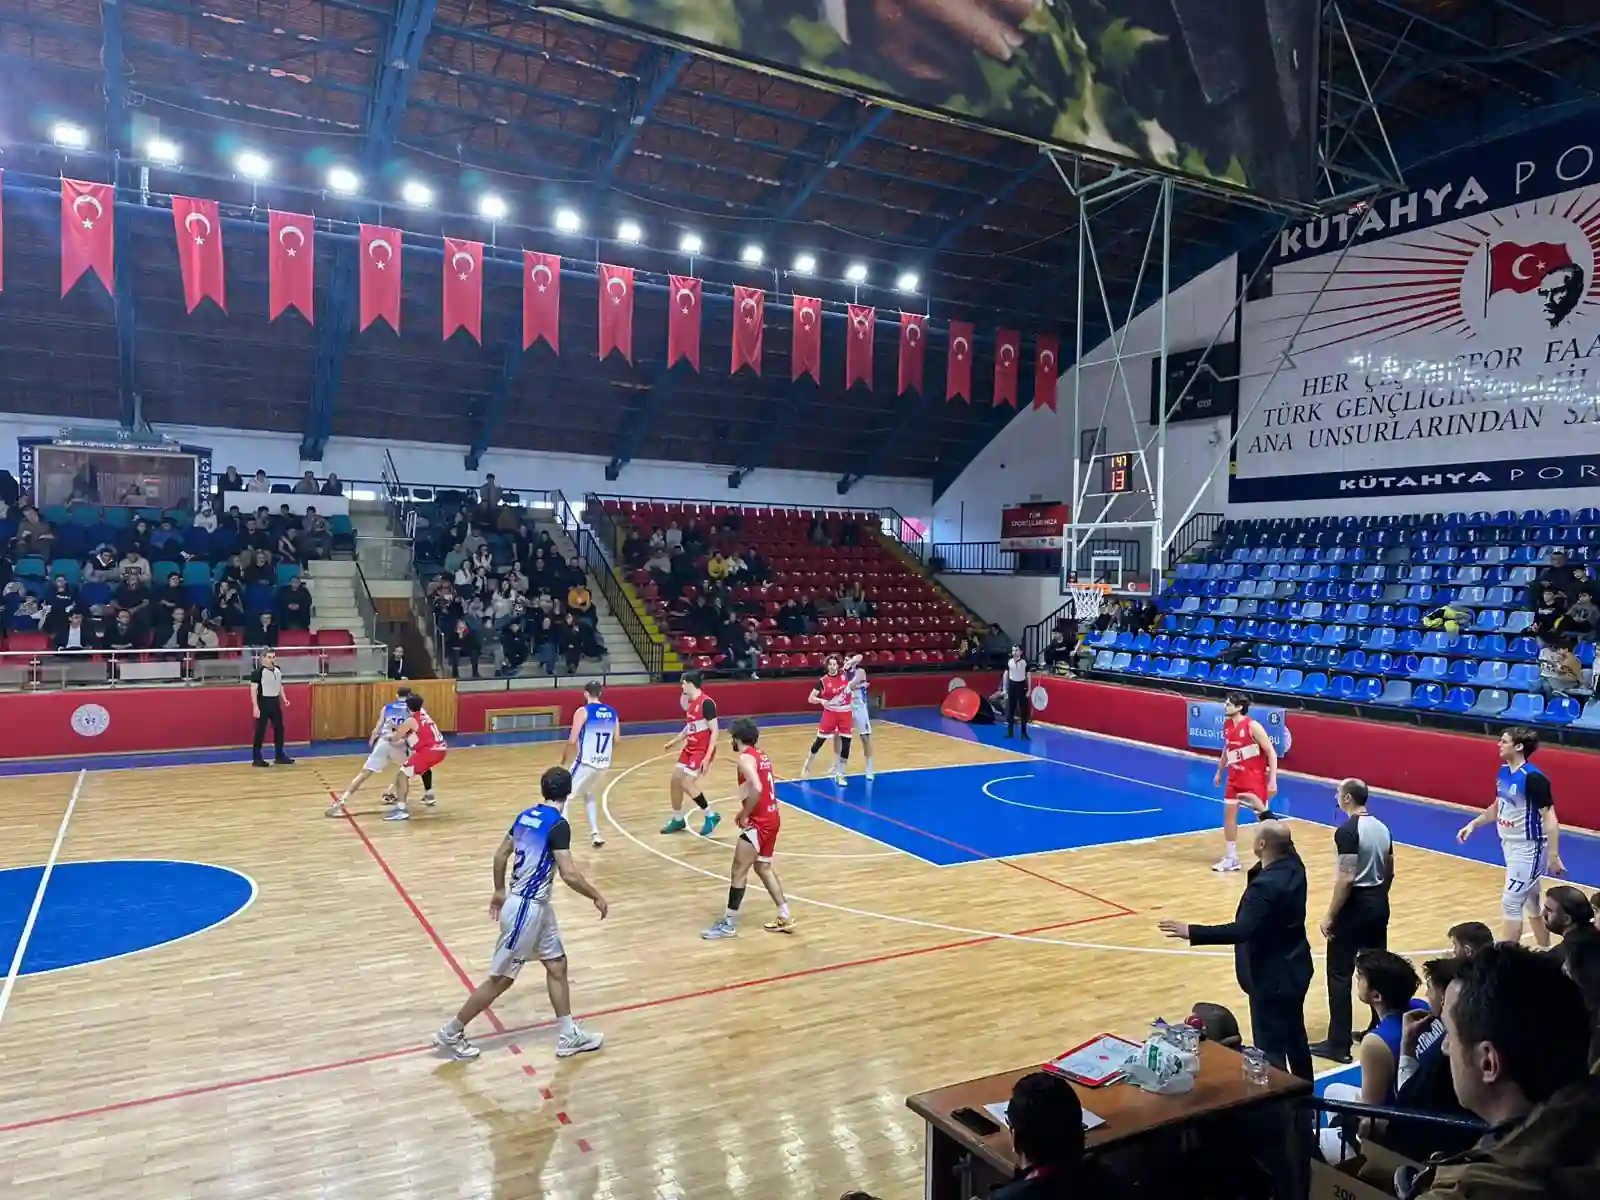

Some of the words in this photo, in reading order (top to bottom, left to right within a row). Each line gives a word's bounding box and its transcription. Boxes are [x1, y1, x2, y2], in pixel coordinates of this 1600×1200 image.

[1279, 175, 1489, 257] KÜTAHYA
[1302, 372, 1349, 397] HER
[1263, 402, 1324, 428] TÜRK
[1248, 432, 1293, 454] ANA
[1308, 405, 1544, 449] UNSURLARINDAN
[1339, 471, 1492, 490] KÜTAHYA
[596, 732, 611, 754] 17
[1508, 878, 1526, 893] 77
